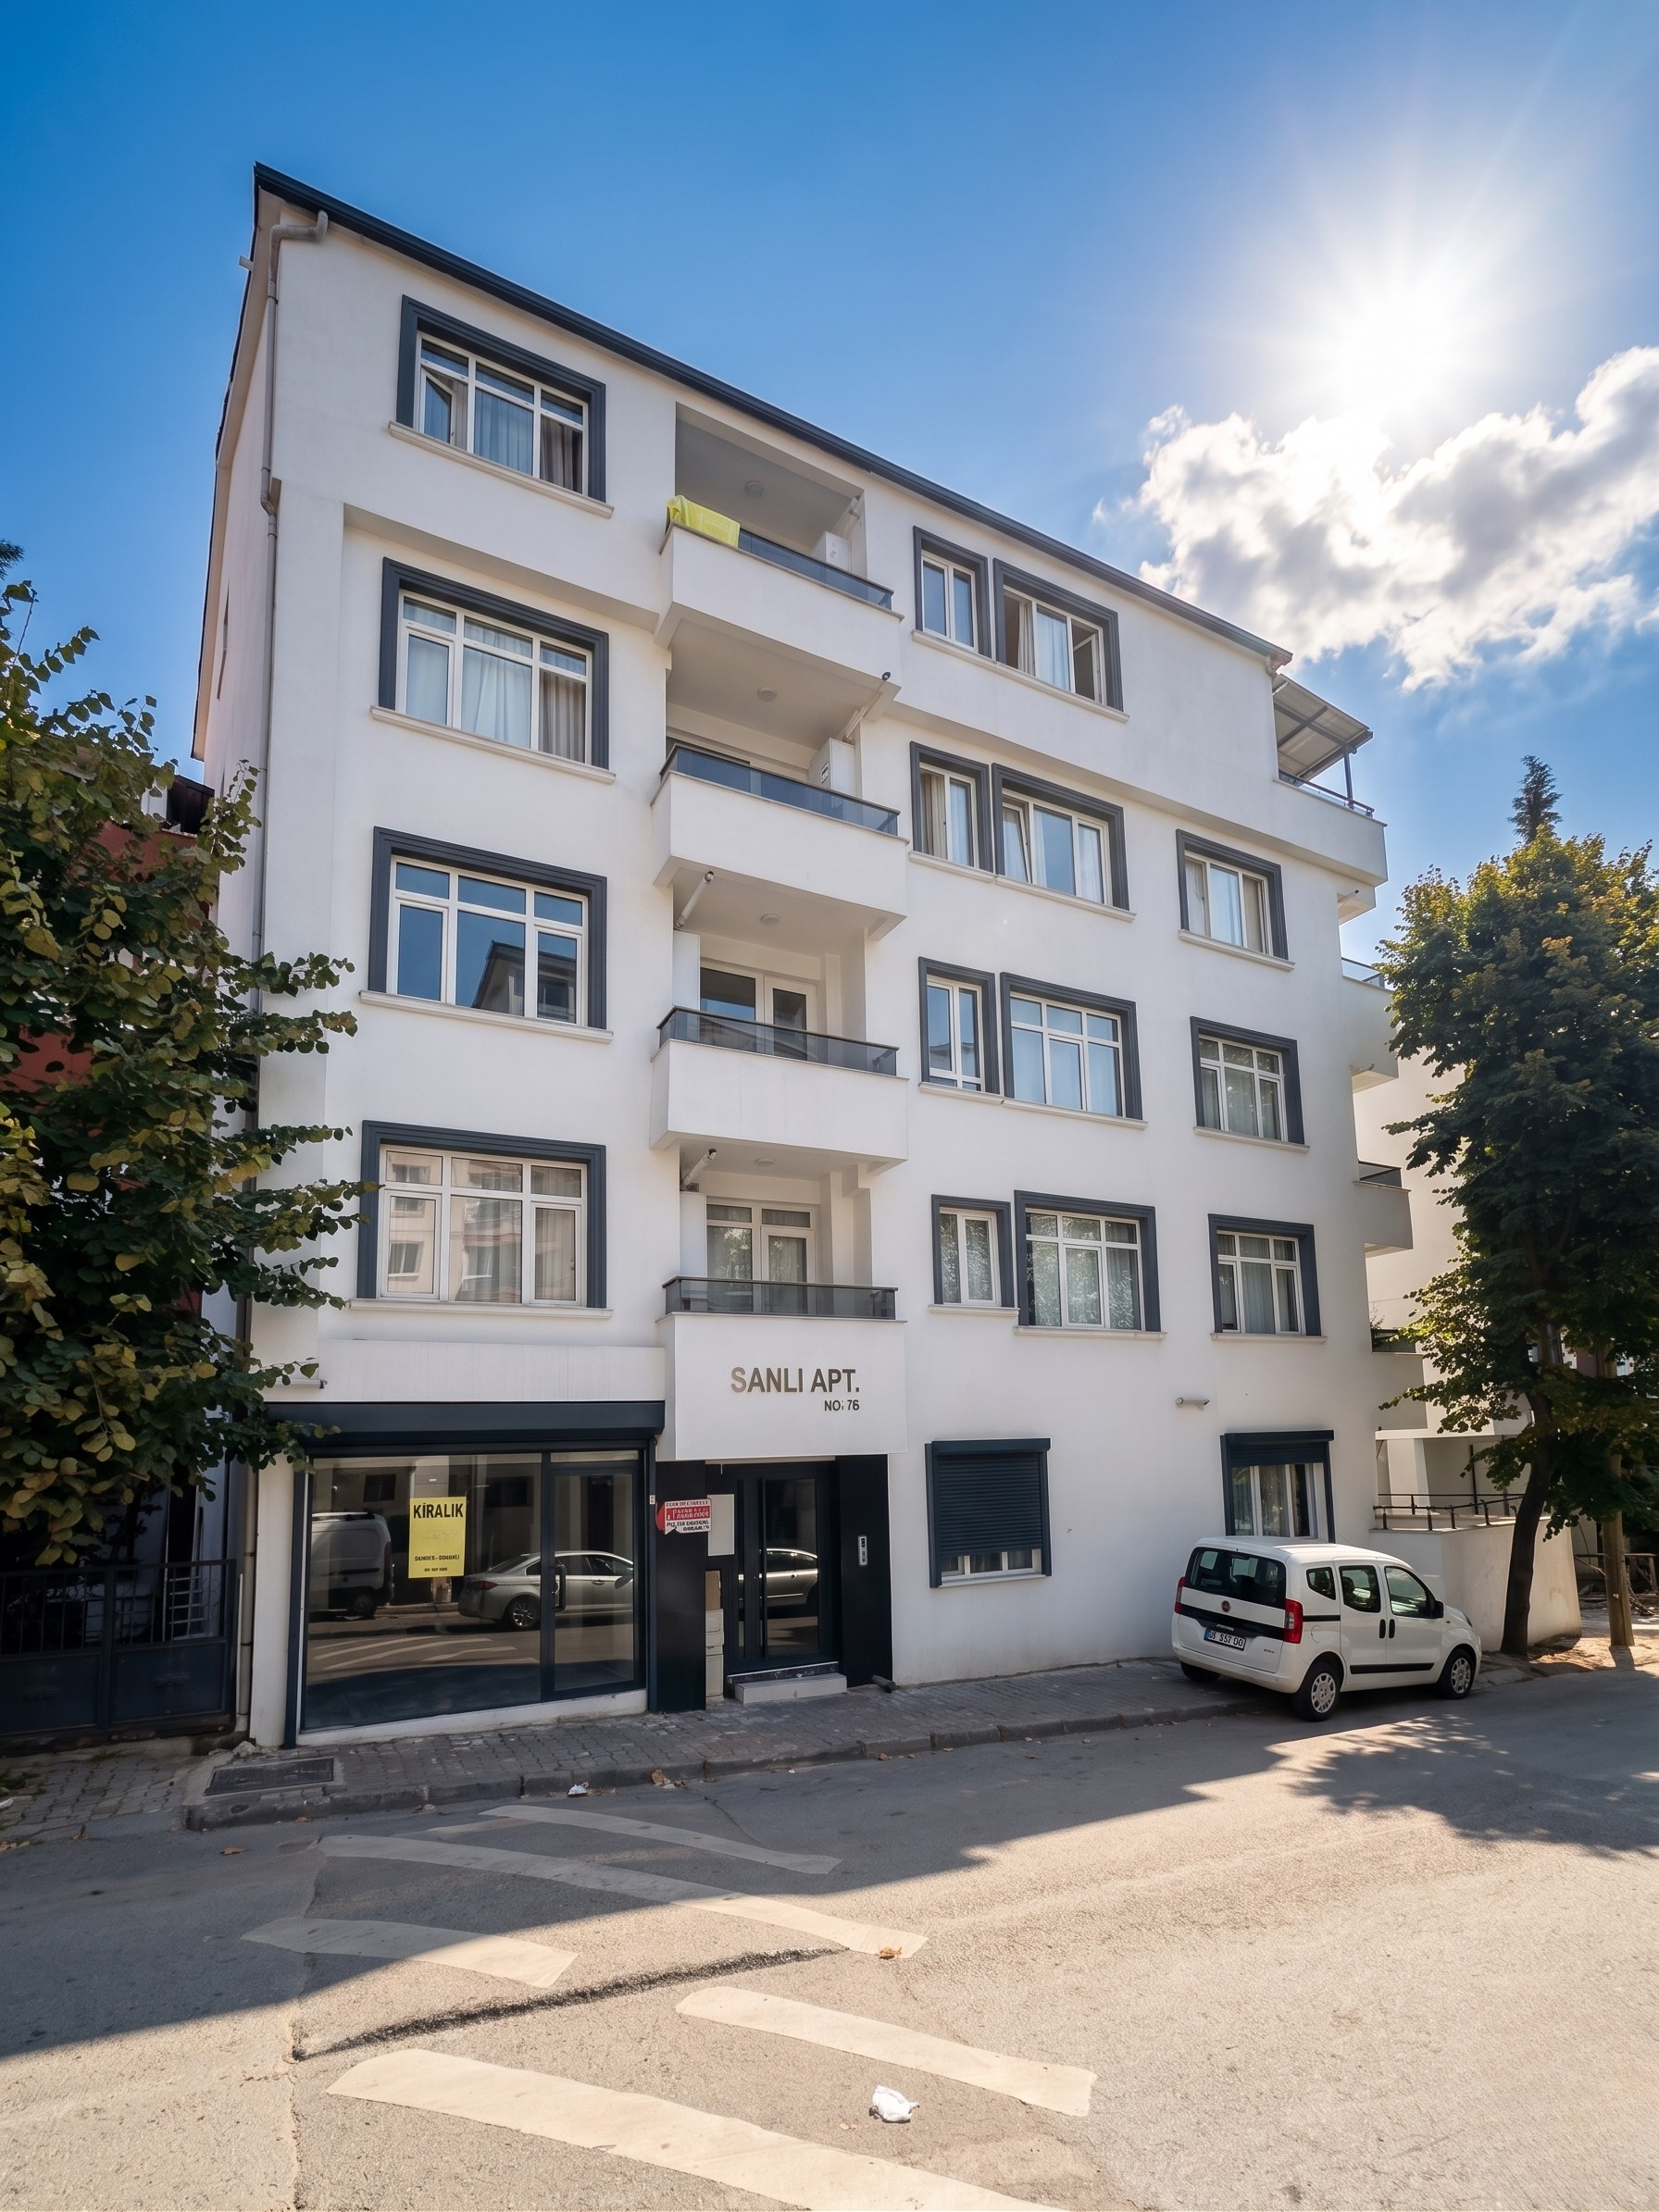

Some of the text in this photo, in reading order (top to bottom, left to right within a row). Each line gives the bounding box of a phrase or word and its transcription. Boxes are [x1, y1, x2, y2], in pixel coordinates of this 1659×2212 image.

[730, 1367, 860, 1393] SANLI APT.
[847, 1399, 860, 1410] 76
[413, 1502, 464, 1519] KİRALIK
